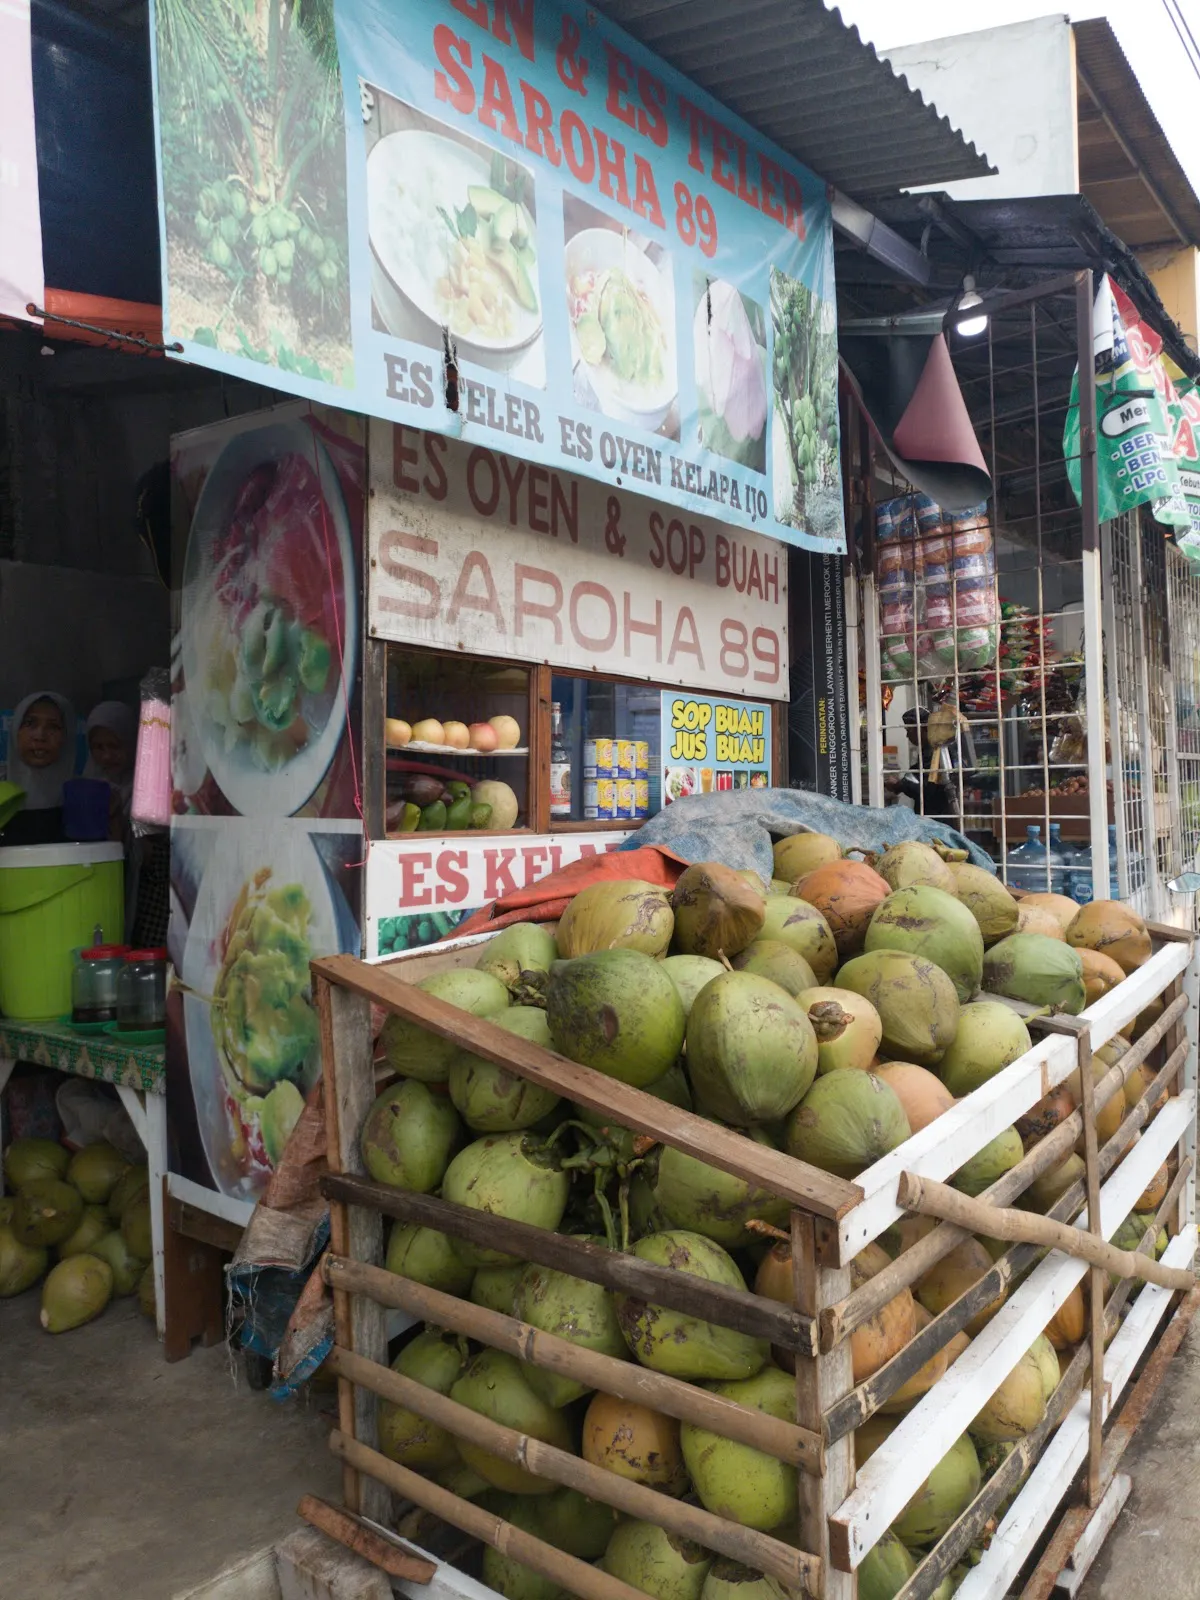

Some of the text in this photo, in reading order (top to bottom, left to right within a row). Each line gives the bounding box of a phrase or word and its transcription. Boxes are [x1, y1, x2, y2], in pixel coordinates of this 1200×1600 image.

[433, 23, 718, 258] SAROHA 89
[555, 14, 589, 97] &
[603, 38, 668, 148] ES
[680, 96, 806, 242] TELER
[383, 353, 768, 522] ES ELER ES OYEN KELAPA IJO
[392, 421, 779, 605] ES OYEN & SOP BUAH
[378, 528, 780, 684] SAROHA 89
[823, 567, 831, 611] MEROKOK
[835, 571, 843, 619] PEREMPUAN
[824, 612, 833, 655] BERHENTI
[826, 656, 834, 695] LAYANAN
[671, 699, 765, 736] SOP BUAH
[819, 697, 827, 754] PERINGATAN:
[671, 730, 708, 761] JUS
[716, 734, 766, 764] BUAH
[398, 850, 470, 908] ES
